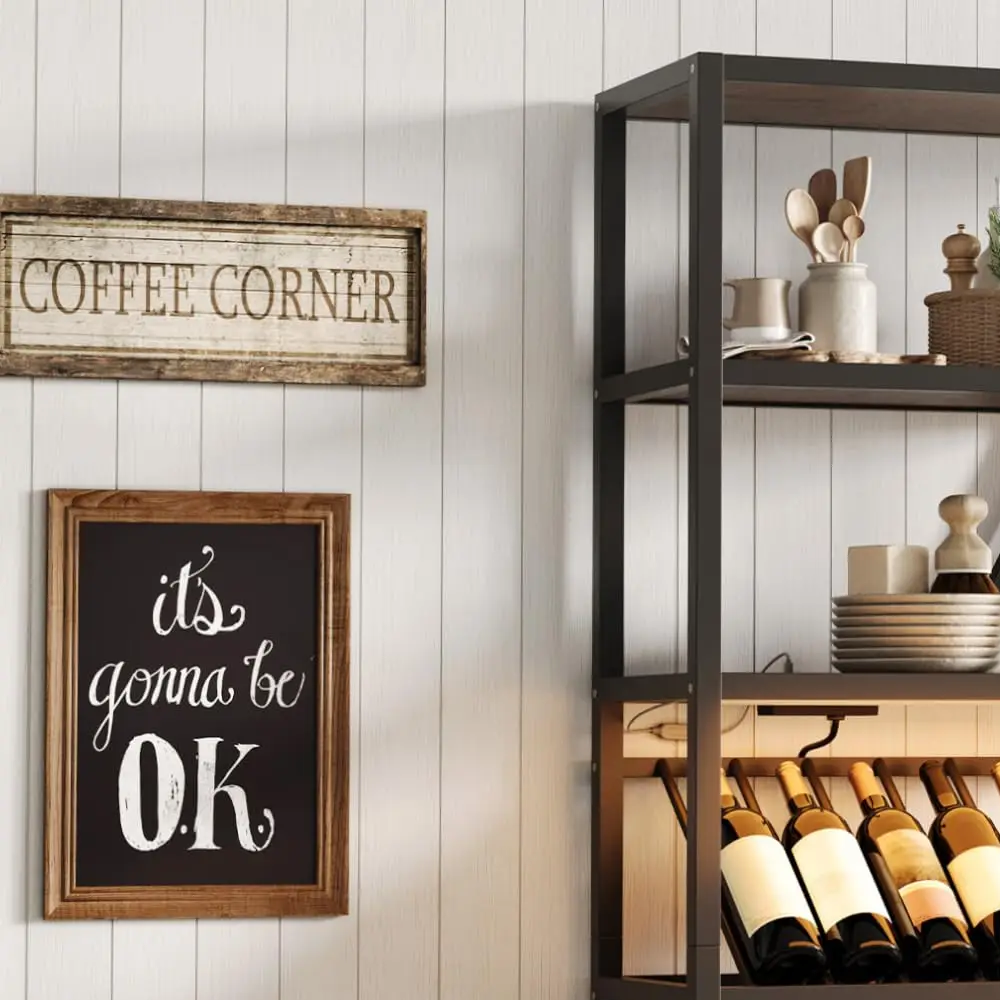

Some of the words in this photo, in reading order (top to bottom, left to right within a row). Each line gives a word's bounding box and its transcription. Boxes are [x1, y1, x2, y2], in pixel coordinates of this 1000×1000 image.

[20, 258, 195, 317] COFFEE
[210, 264, 399, 323] CORNER
[152, 545, 245, 636] it's
[88, 661, 234, 752] gonna
[244, 640, 305, 708] be
